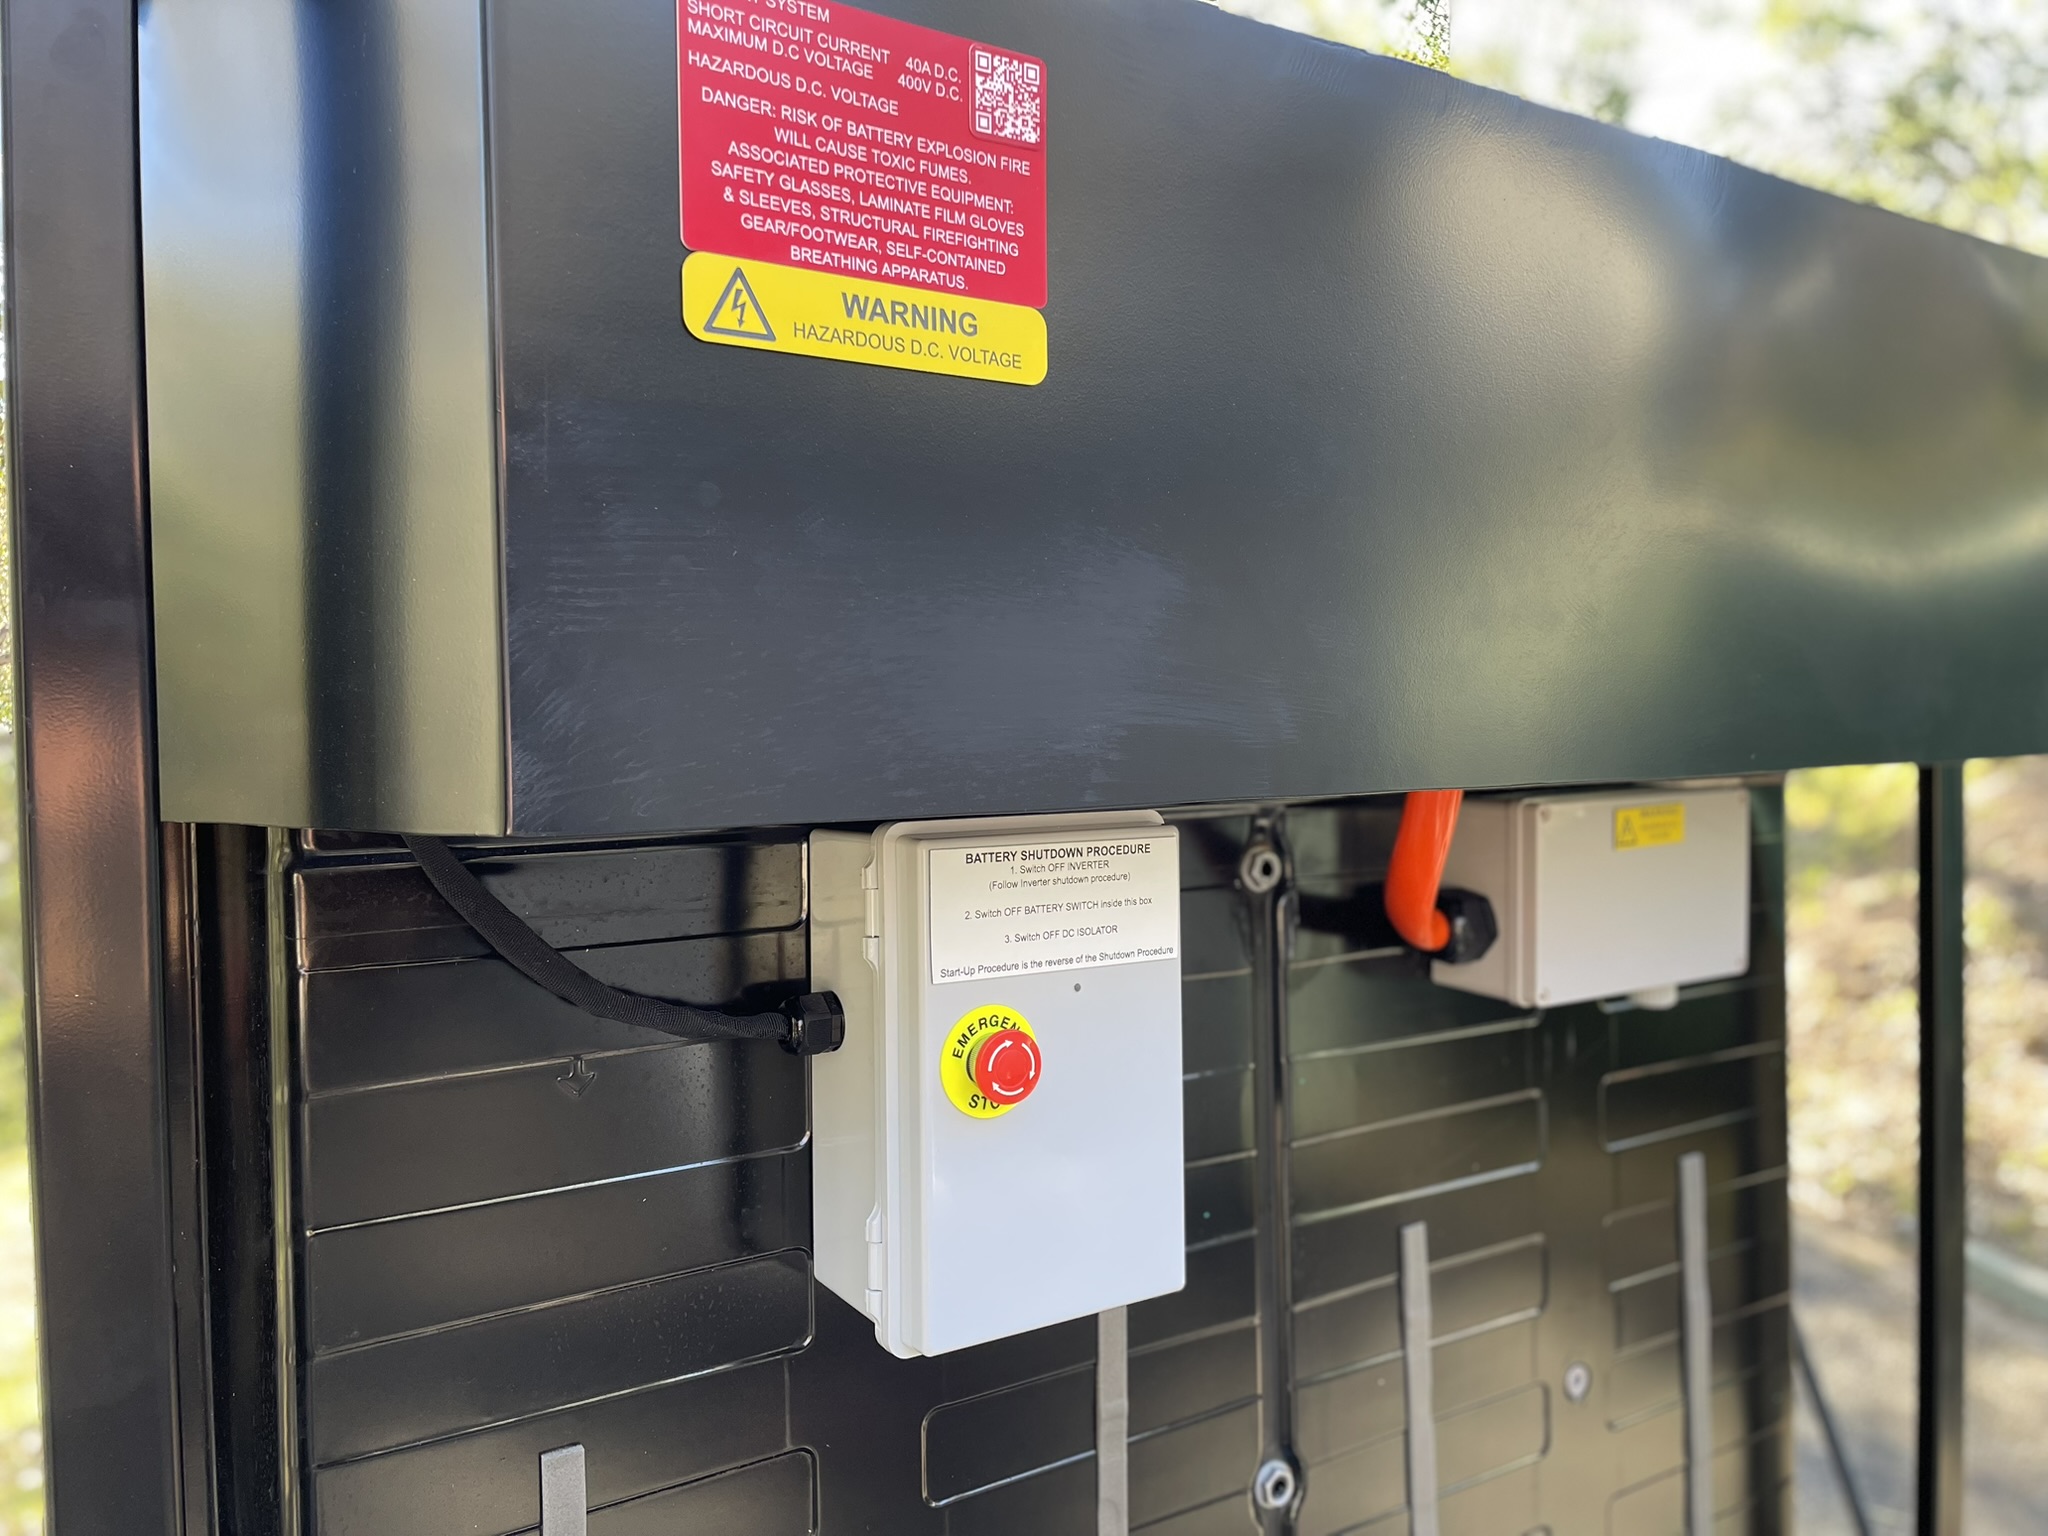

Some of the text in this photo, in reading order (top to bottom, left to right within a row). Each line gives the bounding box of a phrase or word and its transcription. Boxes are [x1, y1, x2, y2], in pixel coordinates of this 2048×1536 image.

[766, 0, 830, 23] SYSTEM
[688, 0, 962, 83] SHORT CIRCUIT CURRENT 40A D.C.
[688, 18, 768, 52] MAXIMUM
[804, 49, 874, 79] VOLTAGE
[898, 74, 932, 95] 400V
[935, 83, 963, 102] D.C.
[688, 51, 899, 116] HAZARDOUS D.C. VOLTAGE
[702, 87, 1031, 176] DANGER: RISK OF BATTERY EXPLOSION FIRE
[774, 126, 972, 184] WILL CAUSE TOXIC FUMES.
[711, 160, 1024, 238] SAFETY GLASSES, LAMINATE FILM GLOVES
[728, 140, 1014, 215] ASSOCIATED PROTECTIVE EQUIPMENT:
[723, 186, 1019, 257] & SLEEVES, STRUCTURAL FIREFIGHTING
[740, 214, 1006, 276] GEAR/FOOTWEAR, SELF-CONTAINED
[790, 245, 969, 291] BREATHING APPARATUS.
[841, 291, 978, 337] WARNING
[793, 321, 1022, 370] HAZARDOUS D.C. VOLTAGE
[965, 843, 1151, 864] BATTERY SHUTDOWN PROCEDURE
[1010, 859, 1110, 875] 1. Switch OFF INVERTER
[988, 871, 1131, 892] (Follow Inverter shutdown procedure)
[964, 896, 1153, 921] 2. Switch OFF BATTERY SWITCH inside this box
[1004, 924, 1118, 944] 3. Switch OFF DC ISOLATOR
[940, 945, 1174, 979] Start-Up Procedure is the reverse of the Shutdown Procedure
